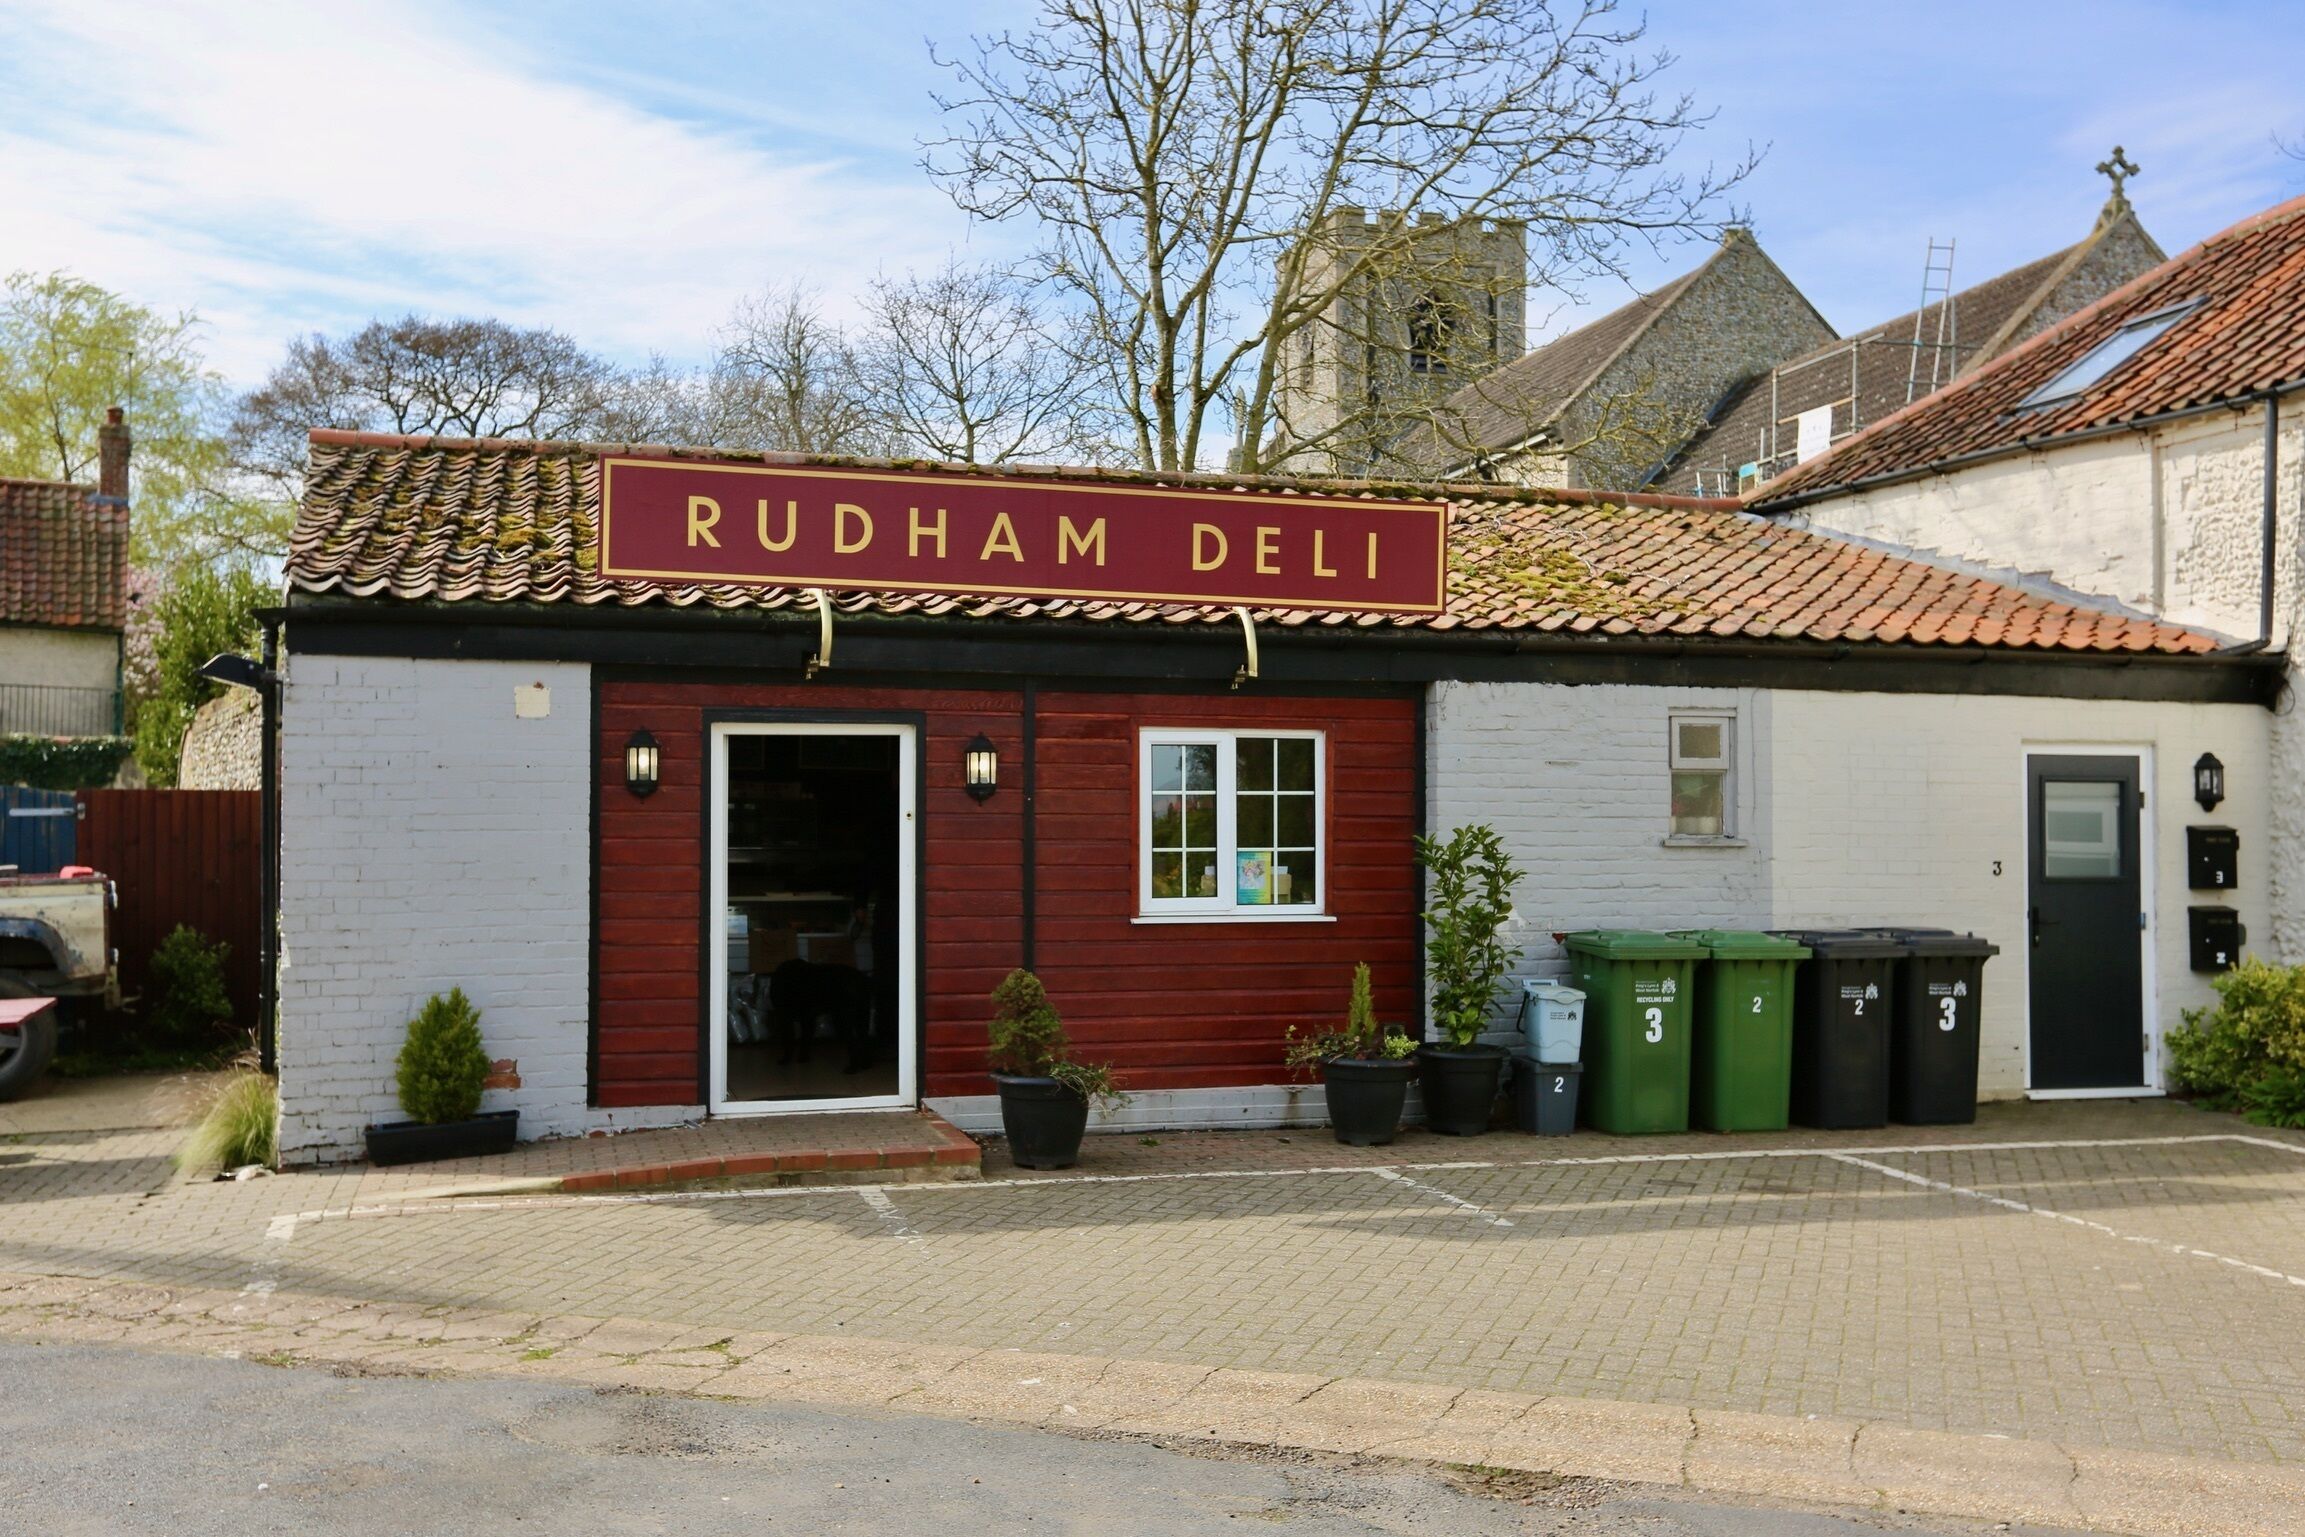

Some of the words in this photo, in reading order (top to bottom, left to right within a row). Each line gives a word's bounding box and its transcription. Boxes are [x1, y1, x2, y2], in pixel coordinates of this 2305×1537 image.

[687, 495, 1107, 566] RUDHAM
[1192, 522, 1377, 579] DELI
[1992, 860, 2002, 876] 3
[2215, 870, 2224, 884] 3
[1752, 996, 1762, 1013] 2
[1854, 999, 1864, 1015] 2
[1939, 997, 1956, 1031] 3
[1645, 1007, 1662, 1043] 3
[1554, 1076, 1564, 1093] 2
